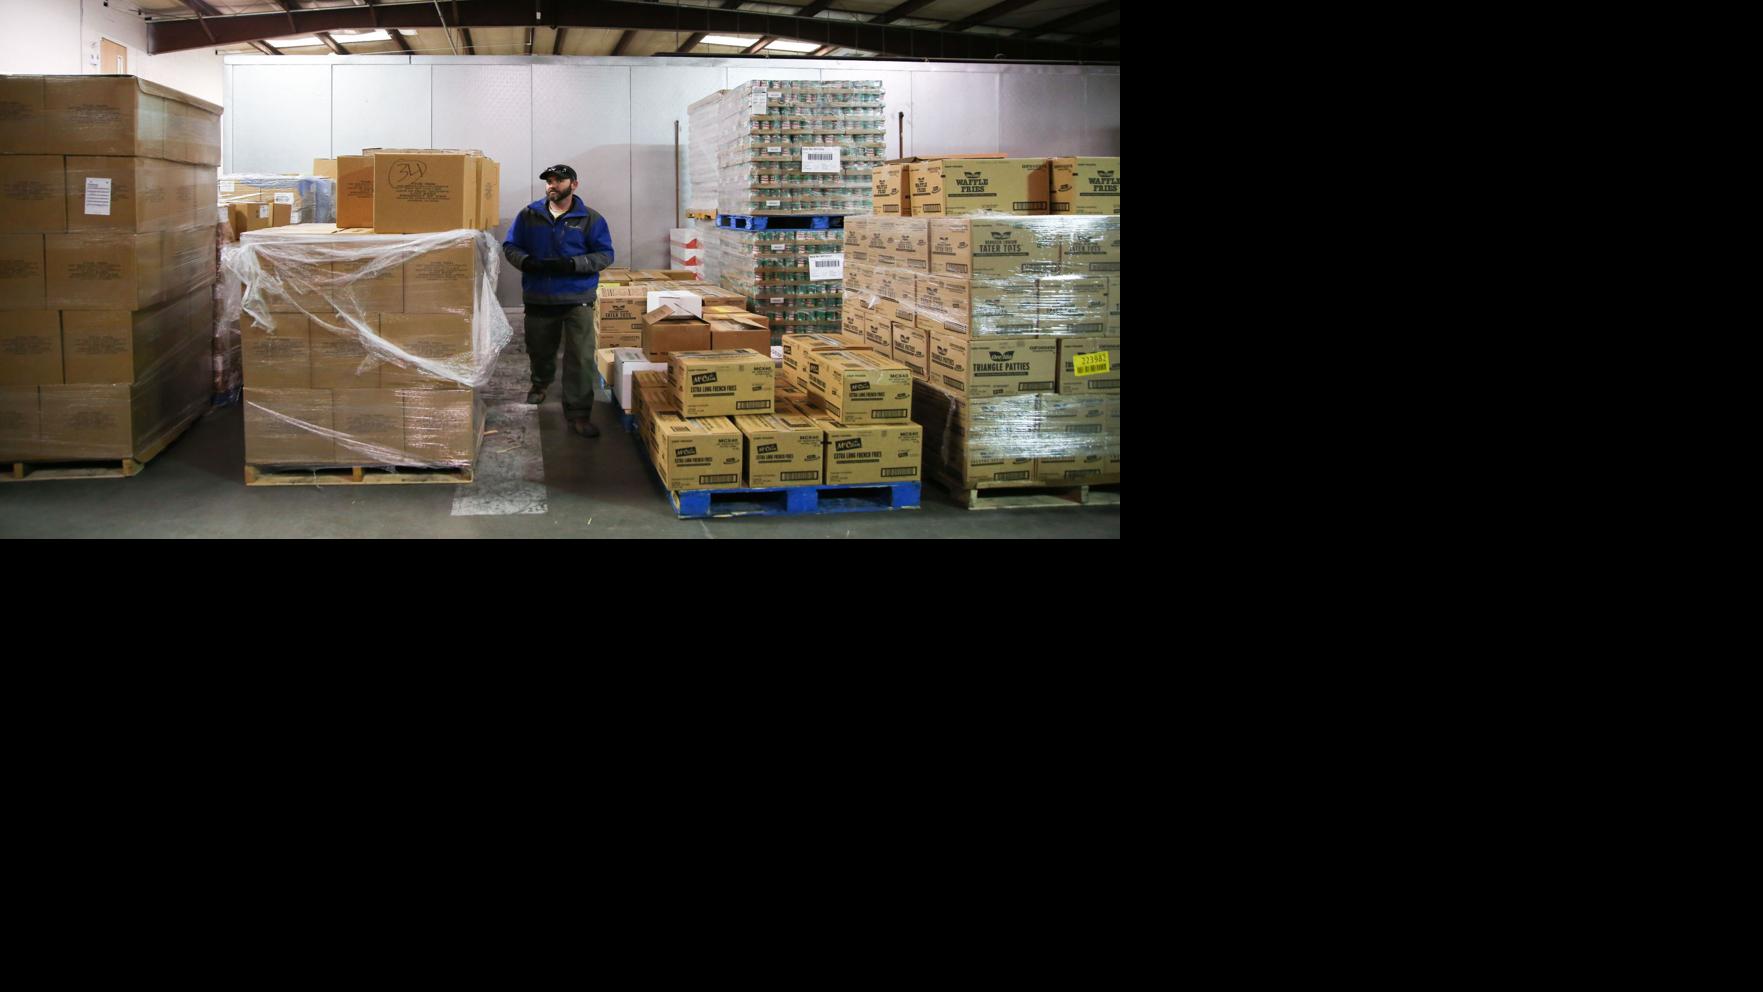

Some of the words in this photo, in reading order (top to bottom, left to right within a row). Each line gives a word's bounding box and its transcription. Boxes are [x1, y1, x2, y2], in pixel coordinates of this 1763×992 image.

[1003, 244, 1021, 252] TOTS
[973, 362, 1003, 371] TRIANGLE
[1005, 362, 1030, 370] PATTIES
